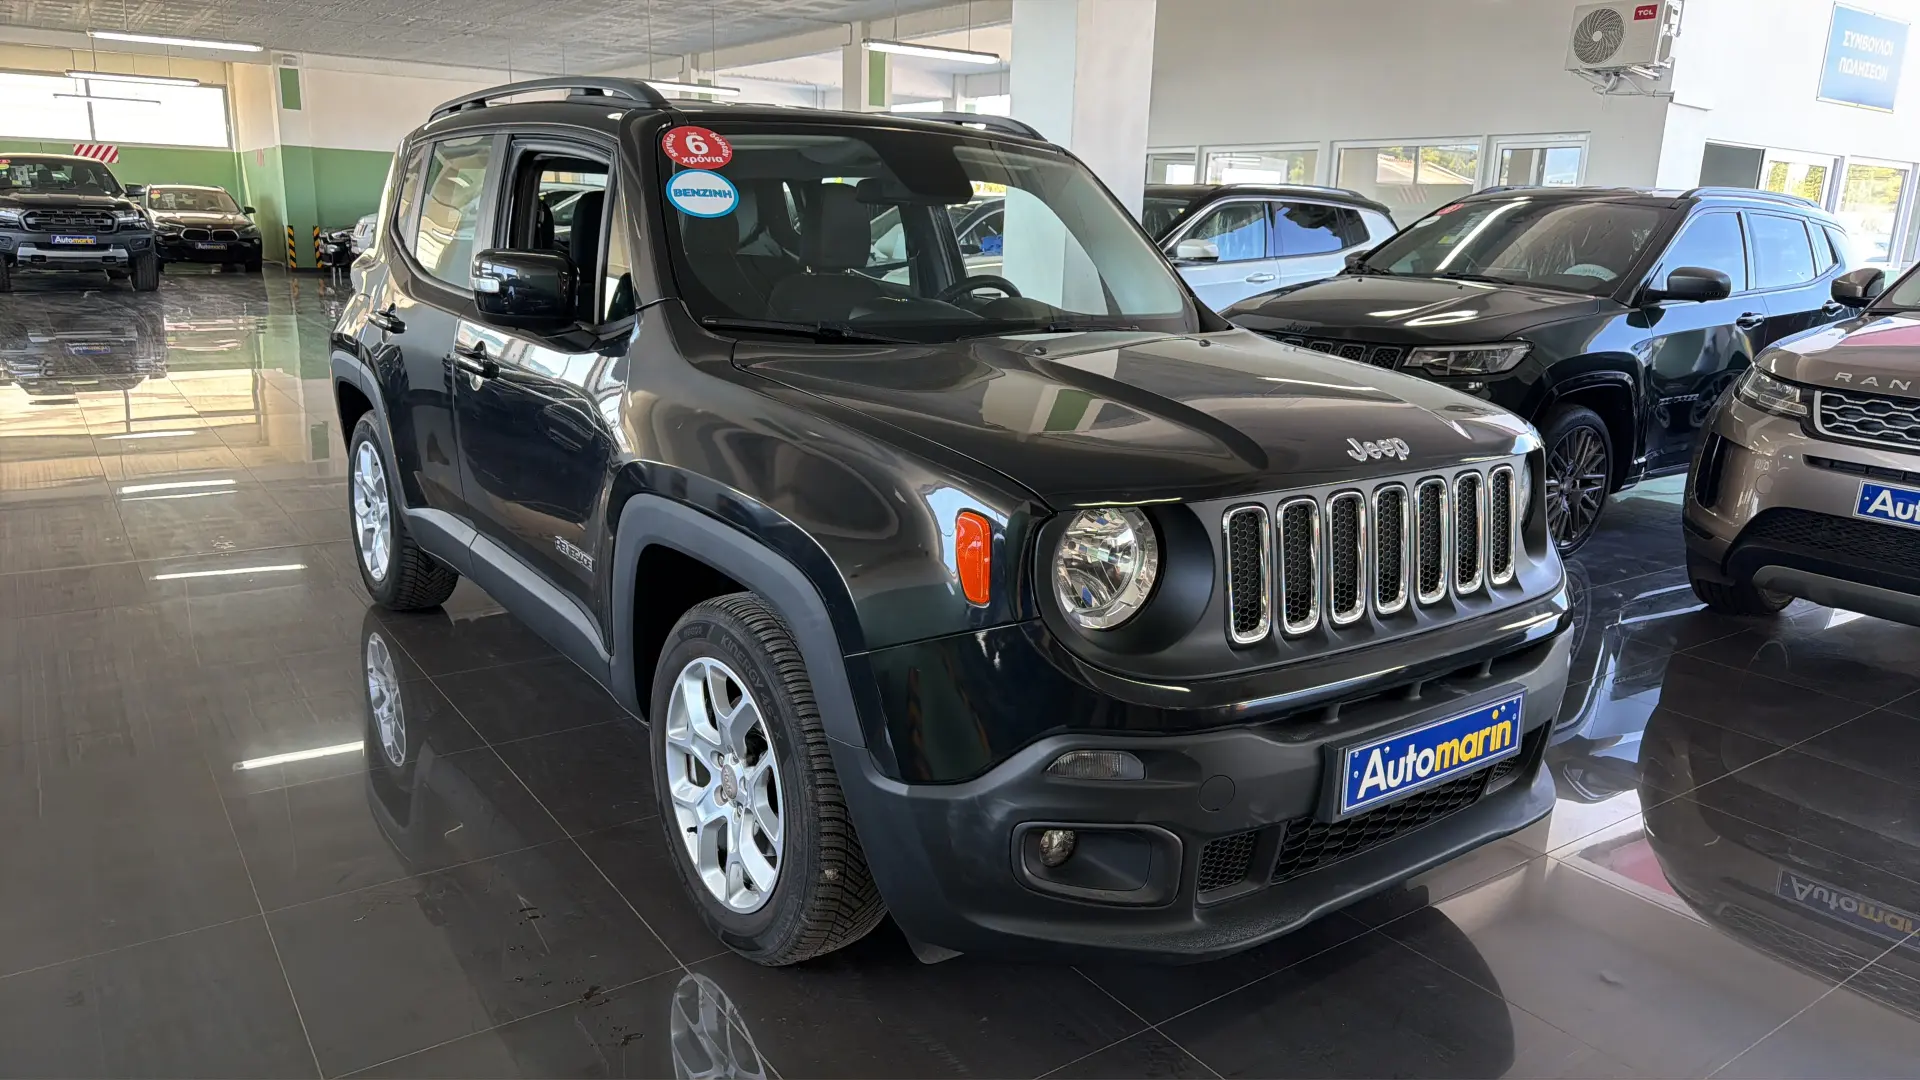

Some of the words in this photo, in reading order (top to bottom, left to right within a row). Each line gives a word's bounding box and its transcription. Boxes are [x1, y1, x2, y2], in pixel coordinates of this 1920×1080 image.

[1842, 30, 1895, 57] ΣΥΜΒΟΥΛΟΙ
[1838, 56, 1889, 82] ΠΩΛΗΣΕΩΝ
[665, 133, 679, 157] service
[685, 135, 709, 155] 6
[681, 155, 724, 164] χρόνια
[55, 236, 94, 244] Automarin
[1834, 372, 1912, 391] RAN
[1347, 437, 1410, 462] Jeep
[720, 634, 765, 689] KINERGY
[1356, 709, 1512, 800] Automarin
